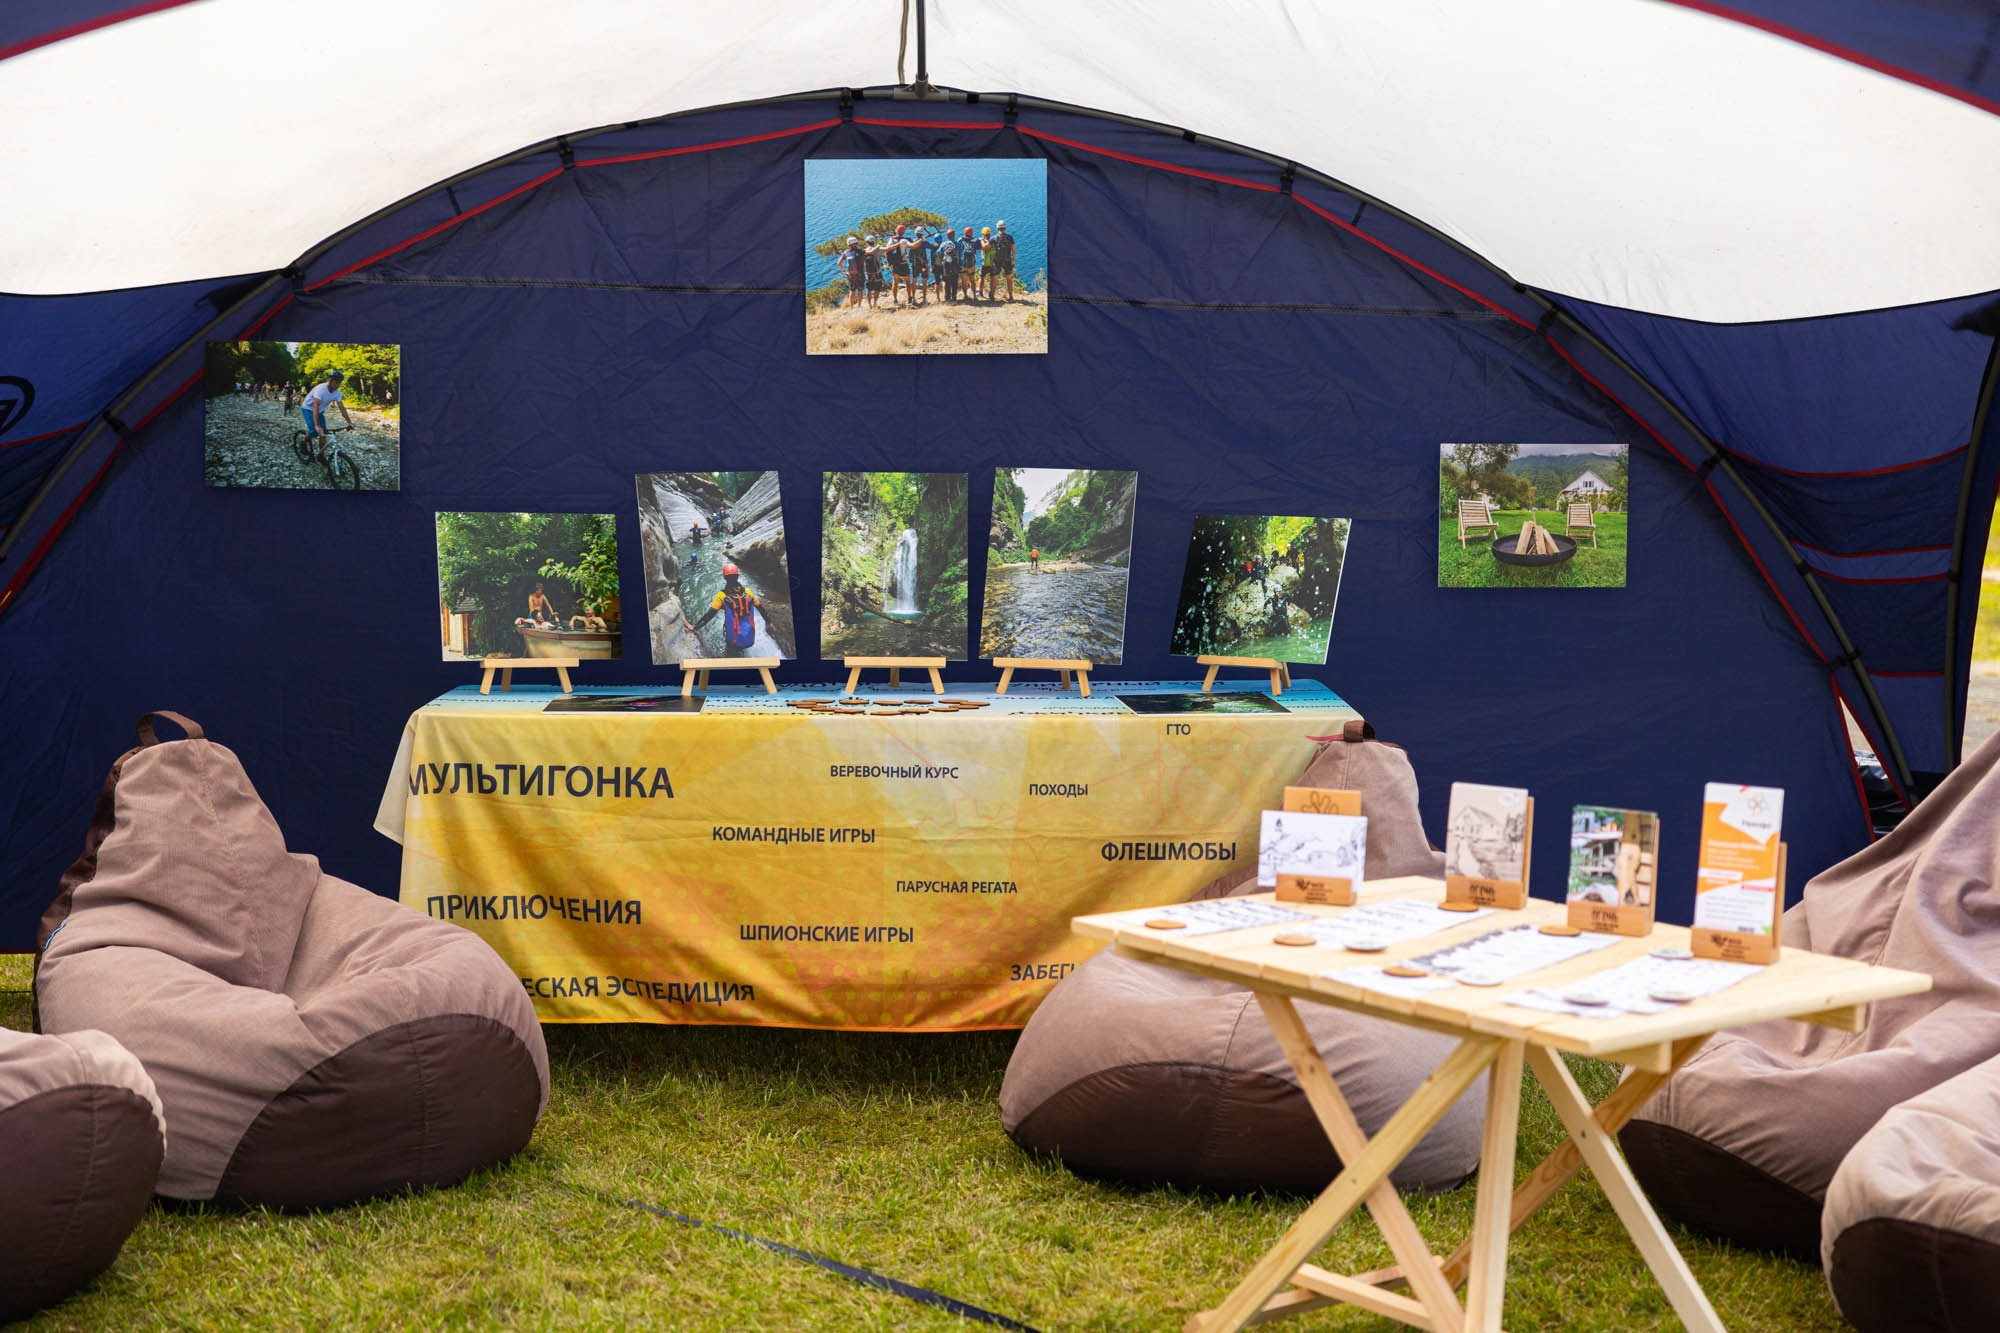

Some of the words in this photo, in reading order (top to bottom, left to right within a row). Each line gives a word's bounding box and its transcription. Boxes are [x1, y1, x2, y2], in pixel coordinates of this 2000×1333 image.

[1166, 723, 1191, 736] ГТО
[408, 762, 674, 799] МУЛЬТИГОНКА
[830, 764, 922, 778] ВЕРЕВОЧНЫЙ
[925, 766, 959, 779] КУРС
[1029, 783, 1088, 798] ПОХОДЫ
[712, 826, 825, 845] КОМАНДНЫЕ
[829, 828, 875, 843] ИГРЫ
[1101, 842, 1237, 862] ФЛЕШМОБЫ
[896, 880, 968, 893] ПАРУСНАЯ
[971, 881, 1018, 894] РЕГАТА
[427, 894, 642, 925] ПРИКЛЮЧЕНИЯ
[740, 924, 859, 942] ШПИОНСКИЕ
[864, 926, 914, 943] ИГРЫ
[606, 975, 756, 1005] ЭСПЕДИЦИЯ
